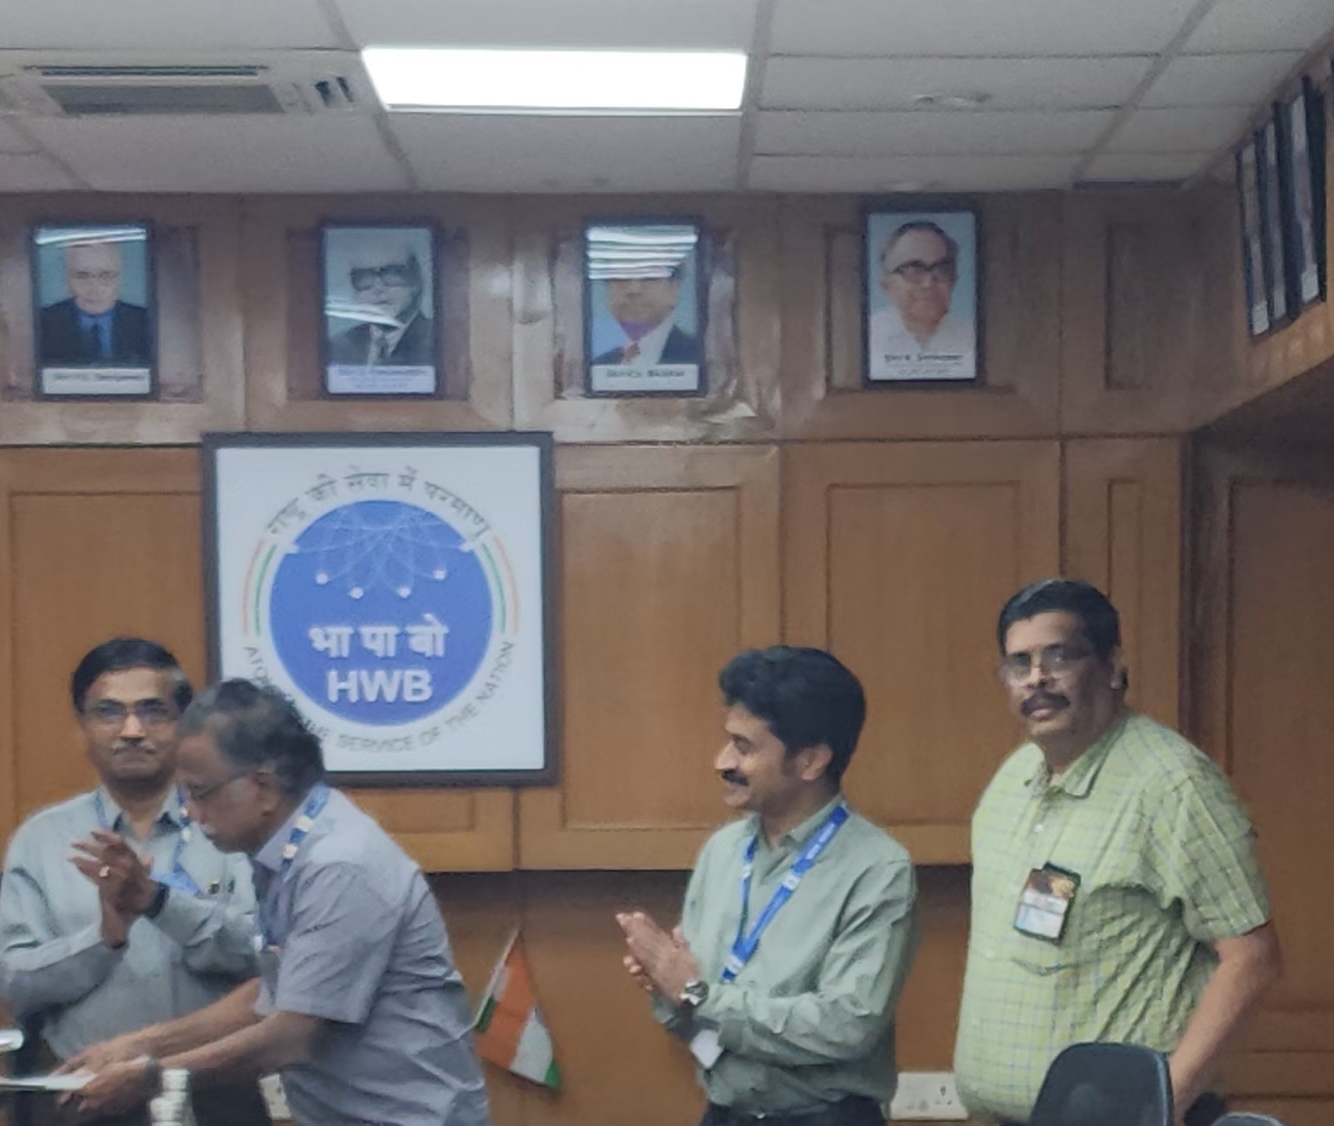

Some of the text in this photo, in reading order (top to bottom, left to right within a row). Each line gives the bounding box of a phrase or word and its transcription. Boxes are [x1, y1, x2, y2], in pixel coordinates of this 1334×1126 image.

[308, 625, 354, 658] भा
[359, 625, 401, 658] पा
[326, 667, 434, 703] HWB
[337, 732, 415, 753] SERVICE
[419, 726, 442, 746] OF
[445, 702, 480, 733] THE
[476, 640, 514, 703] NATION
